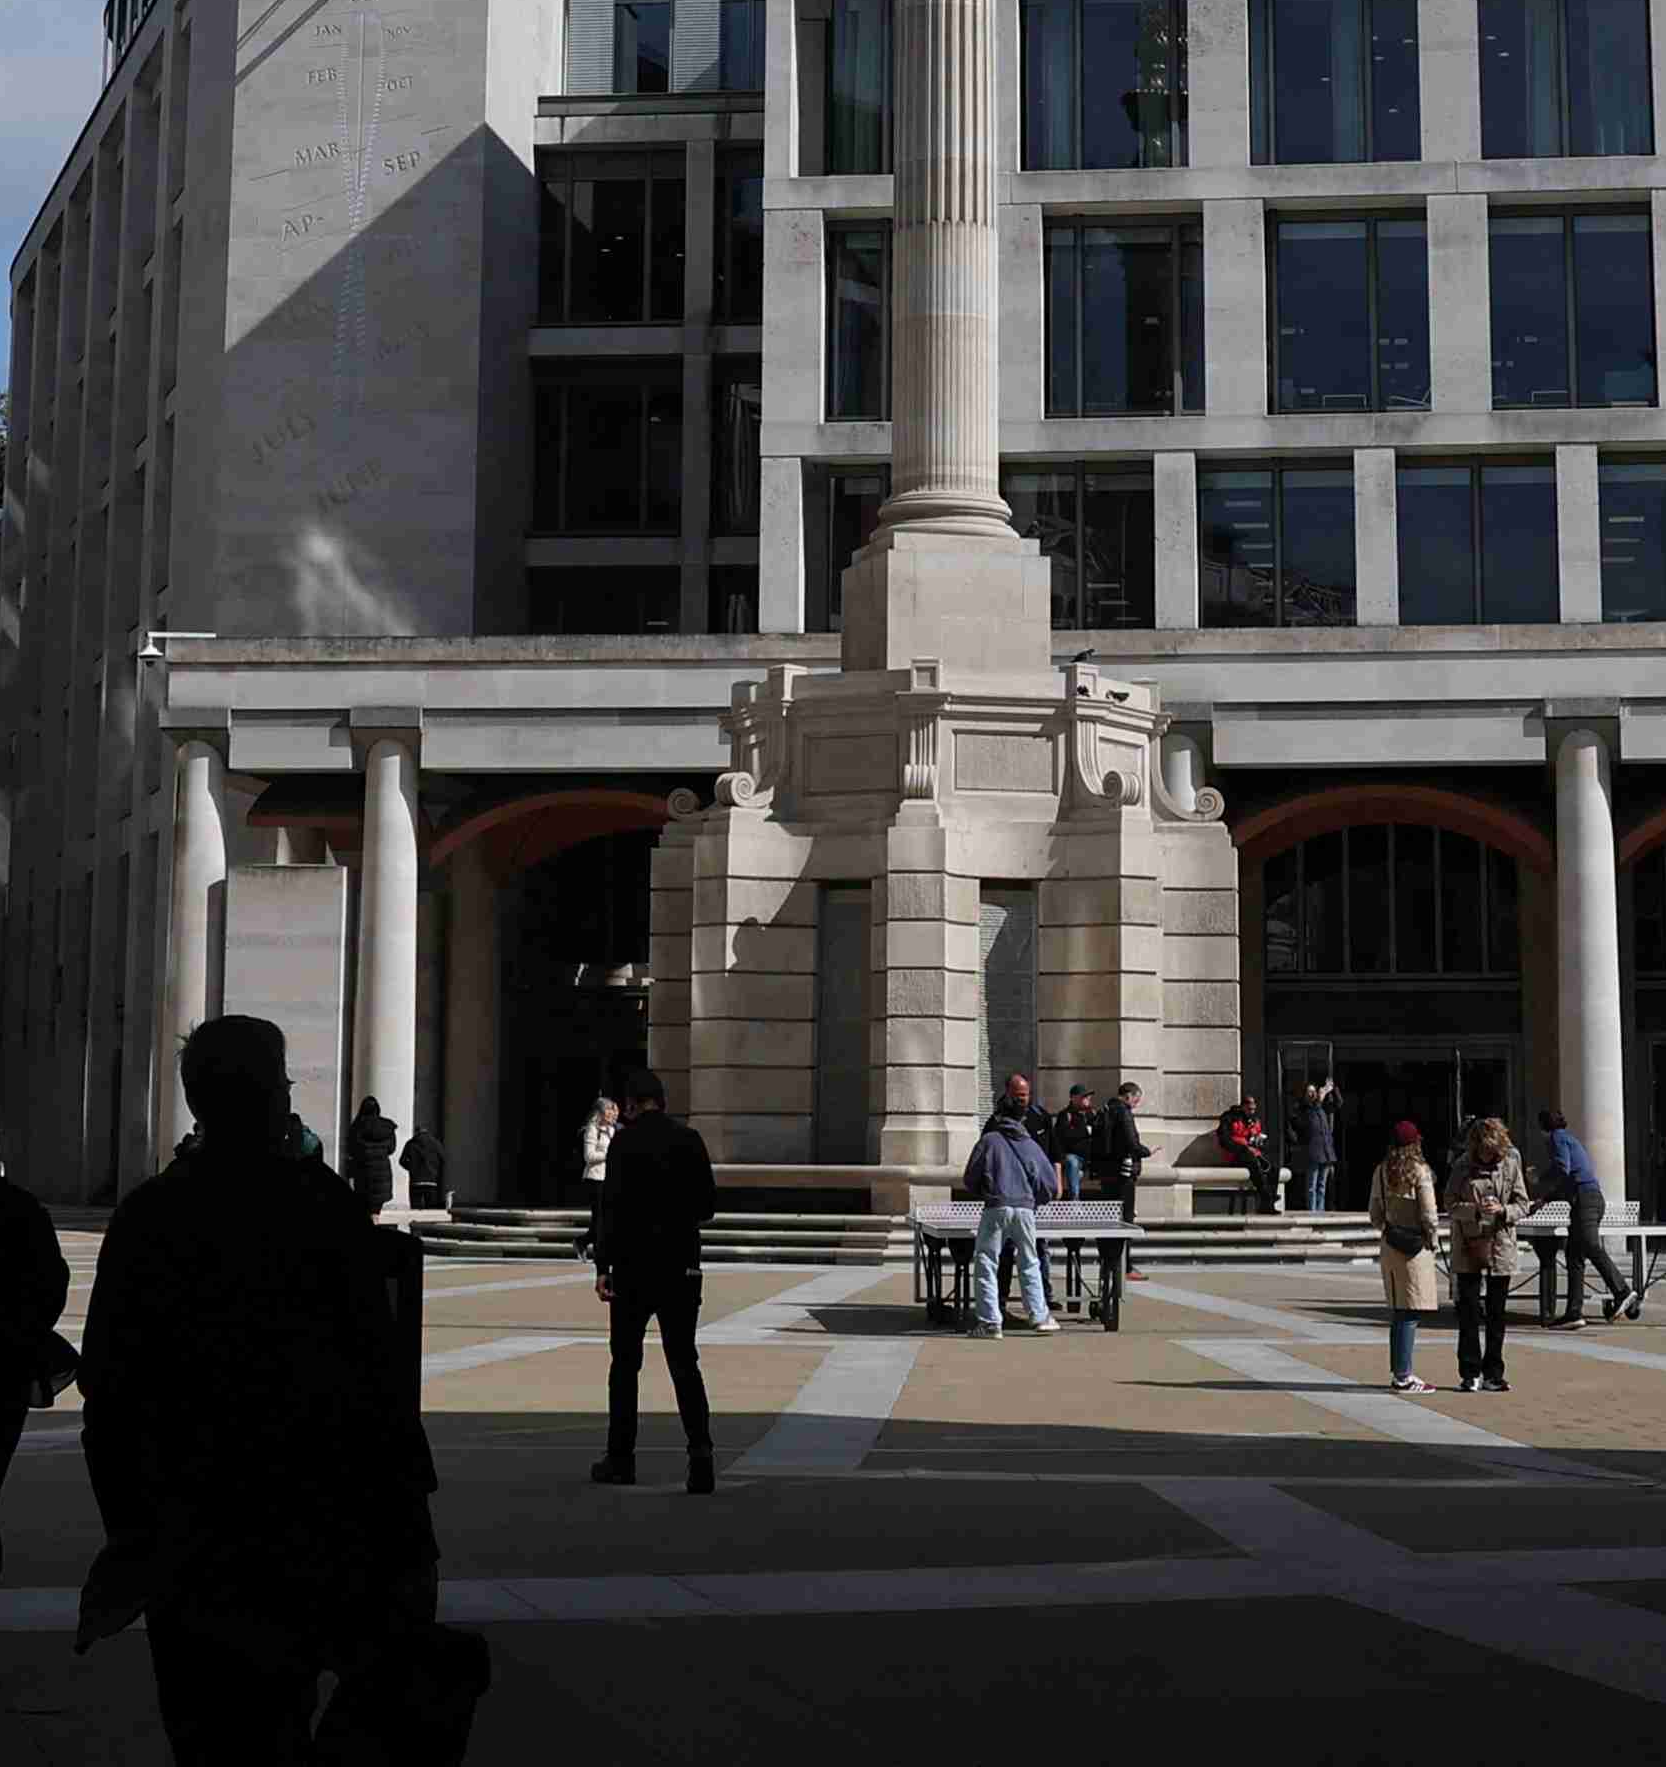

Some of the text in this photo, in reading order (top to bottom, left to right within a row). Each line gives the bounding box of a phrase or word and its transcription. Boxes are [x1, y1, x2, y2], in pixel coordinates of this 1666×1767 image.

[315, 24, 342, 36] JAN
[307, 66, 338, 85] FEB
[384, 75, 414, 91] OCT
[293, 140, 341, 167] MAR
[381, 150, 421, 177] SEP
